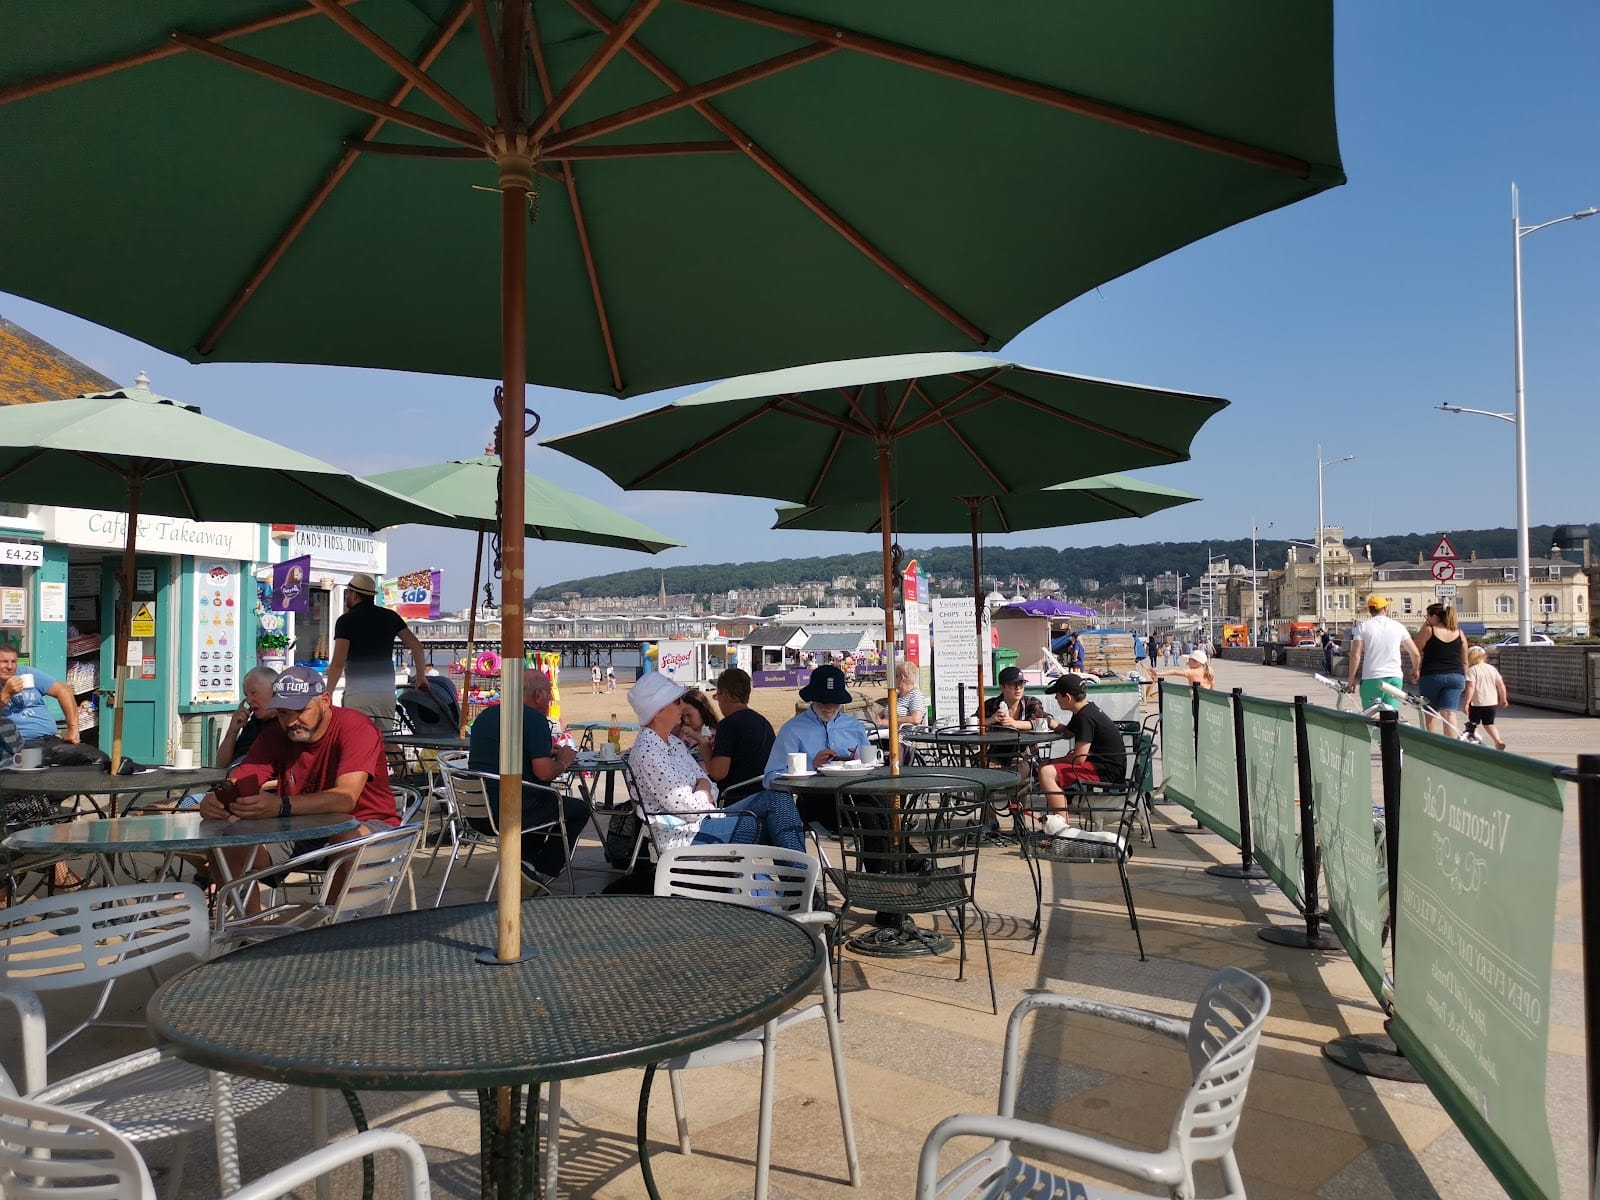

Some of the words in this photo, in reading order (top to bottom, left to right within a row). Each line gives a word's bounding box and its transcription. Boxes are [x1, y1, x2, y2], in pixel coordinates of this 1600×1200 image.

[136, 519, 151, 538] &
[156, 519, 233, 555] Takeaway
[296, 531, 321, 548] CANDY
[347, 538, 374, 554] DONUTS
[6, 549, 39, 561] £4.25
[401, 588, 427, 603] fab
[661, 650, 692, 669] Seafood
[287, 682, 309, 693] FLOYD
